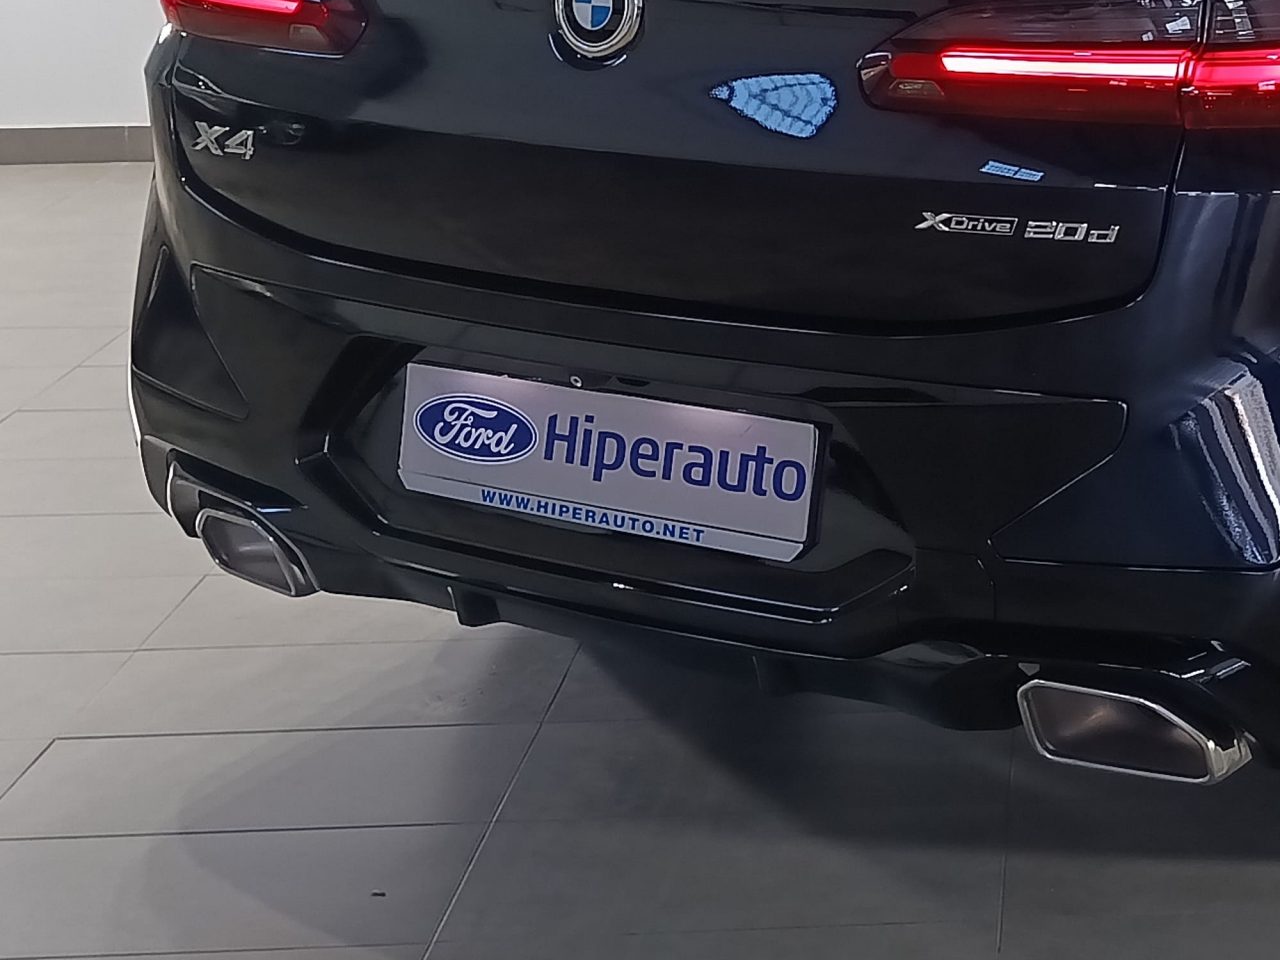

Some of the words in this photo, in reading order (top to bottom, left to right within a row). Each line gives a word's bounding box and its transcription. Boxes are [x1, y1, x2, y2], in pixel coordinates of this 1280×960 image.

[191, 120, 254, 160] X4
[1024, 220, 1120, 243] 20d
[433, 402, 518, 454] Ford
[543, 413, 807, 501] Hiperauto
[481, 488, 706, 542] WWW.HIPERAUTO.NET
